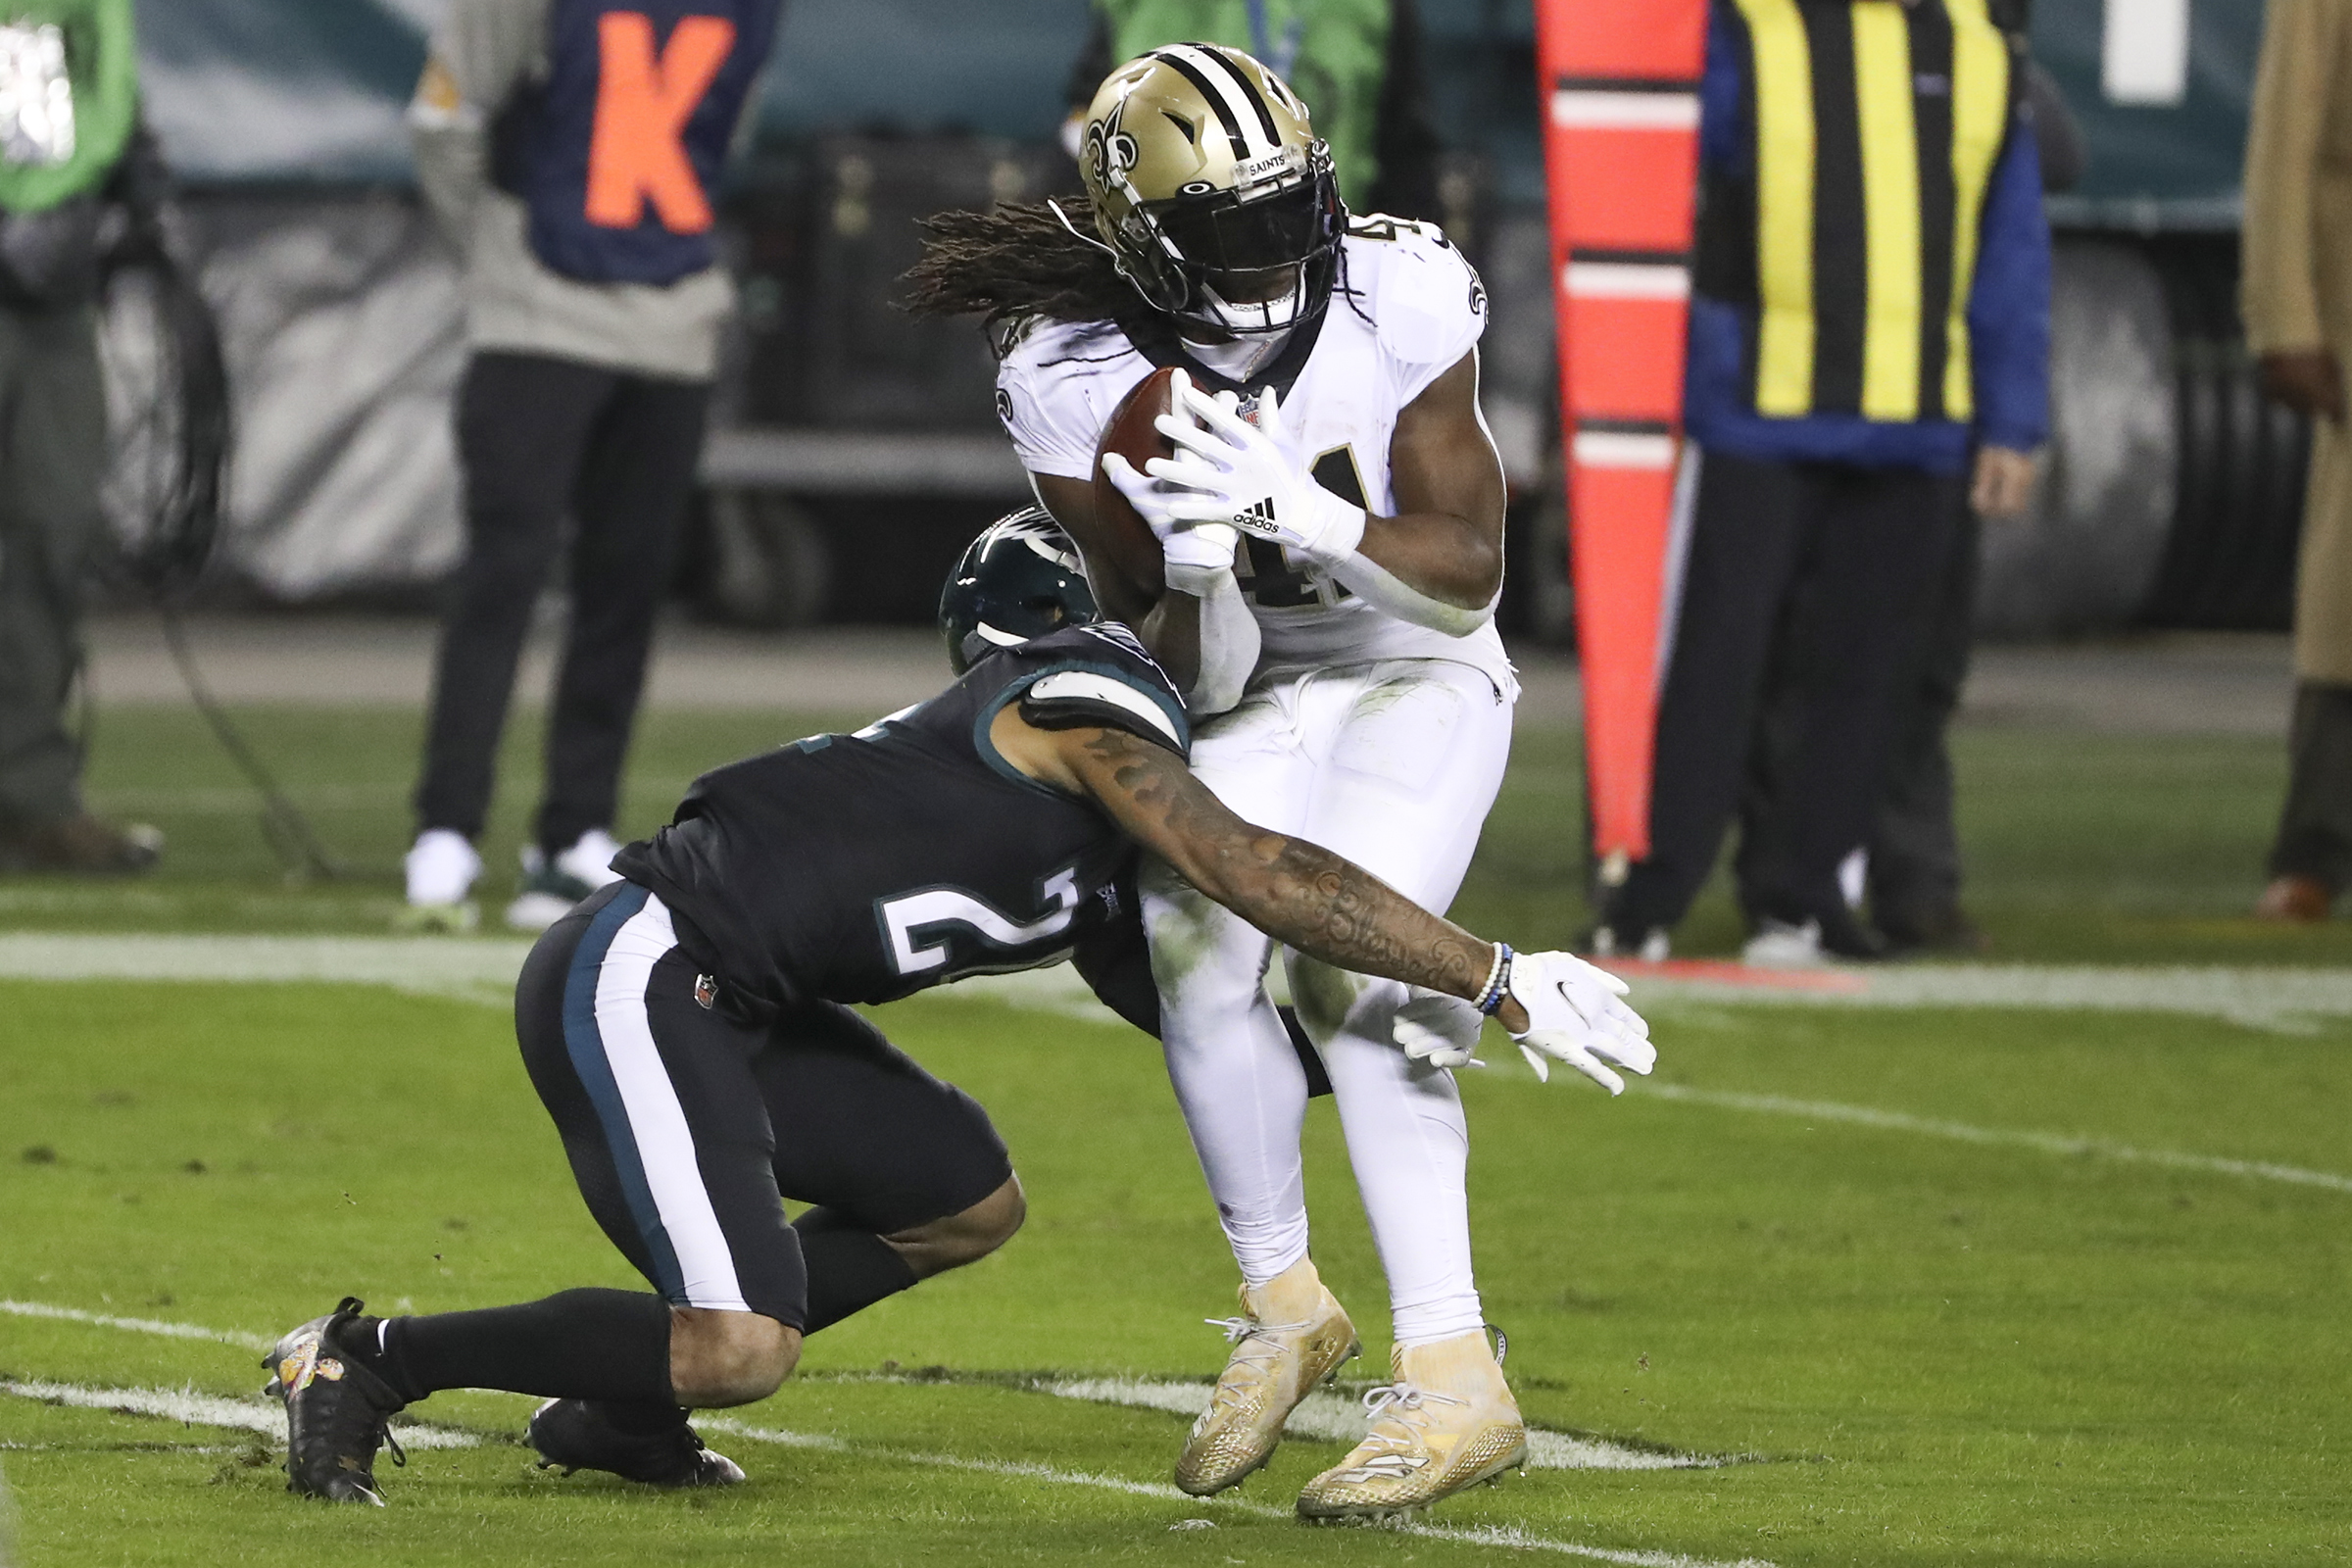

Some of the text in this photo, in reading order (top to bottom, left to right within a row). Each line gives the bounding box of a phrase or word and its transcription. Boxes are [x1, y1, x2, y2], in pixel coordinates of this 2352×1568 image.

[585, 11, 737, 234] K
[1250, 156, 1286, 176] SAINTS
[1234, 514, 1280, 534] adidas
